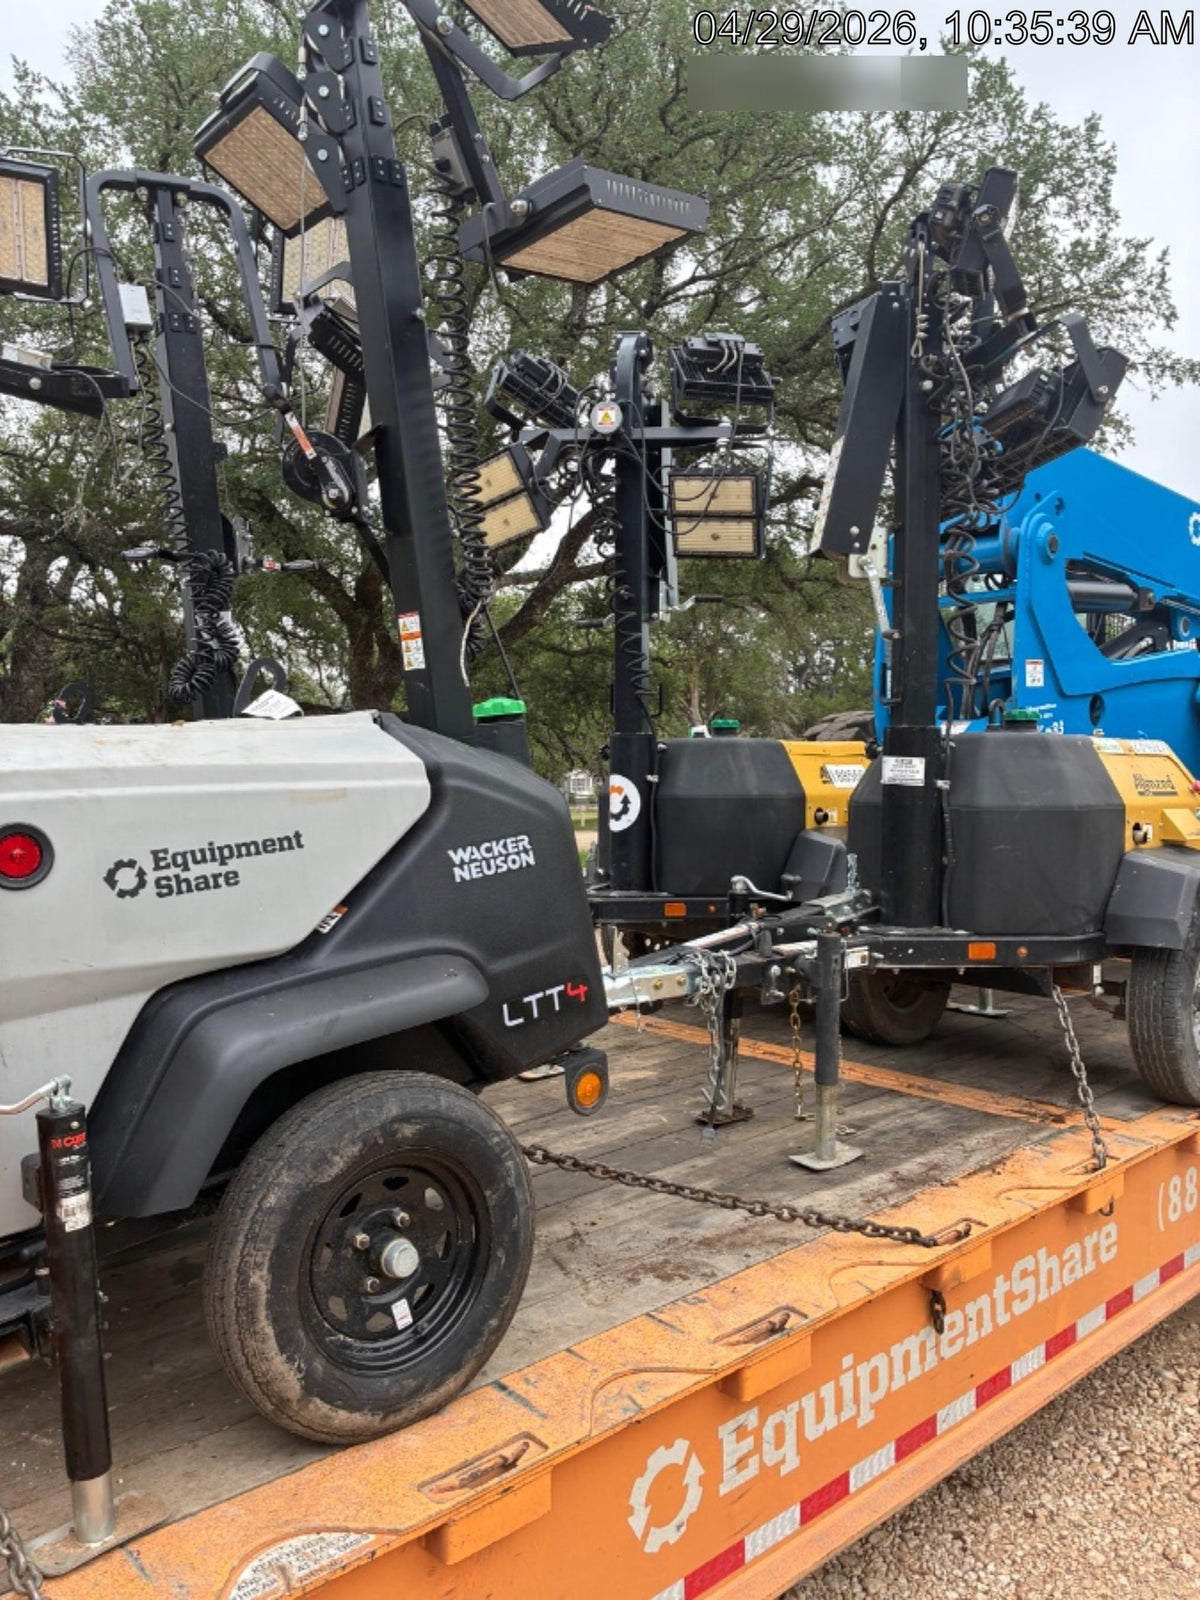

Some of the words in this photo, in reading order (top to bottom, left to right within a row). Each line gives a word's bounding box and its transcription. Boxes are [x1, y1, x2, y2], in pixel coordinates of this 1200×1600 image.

[150, 830, 304, 872] Equipment
[447, 834, 532, 865] WACKER
[453, 851, 536, 882] NEUSON
[154, 869, 240, 898] Share
[502, 982, 588, 1027] LTT4
[718, 1221, 1118, 1496] EquipmentShare
